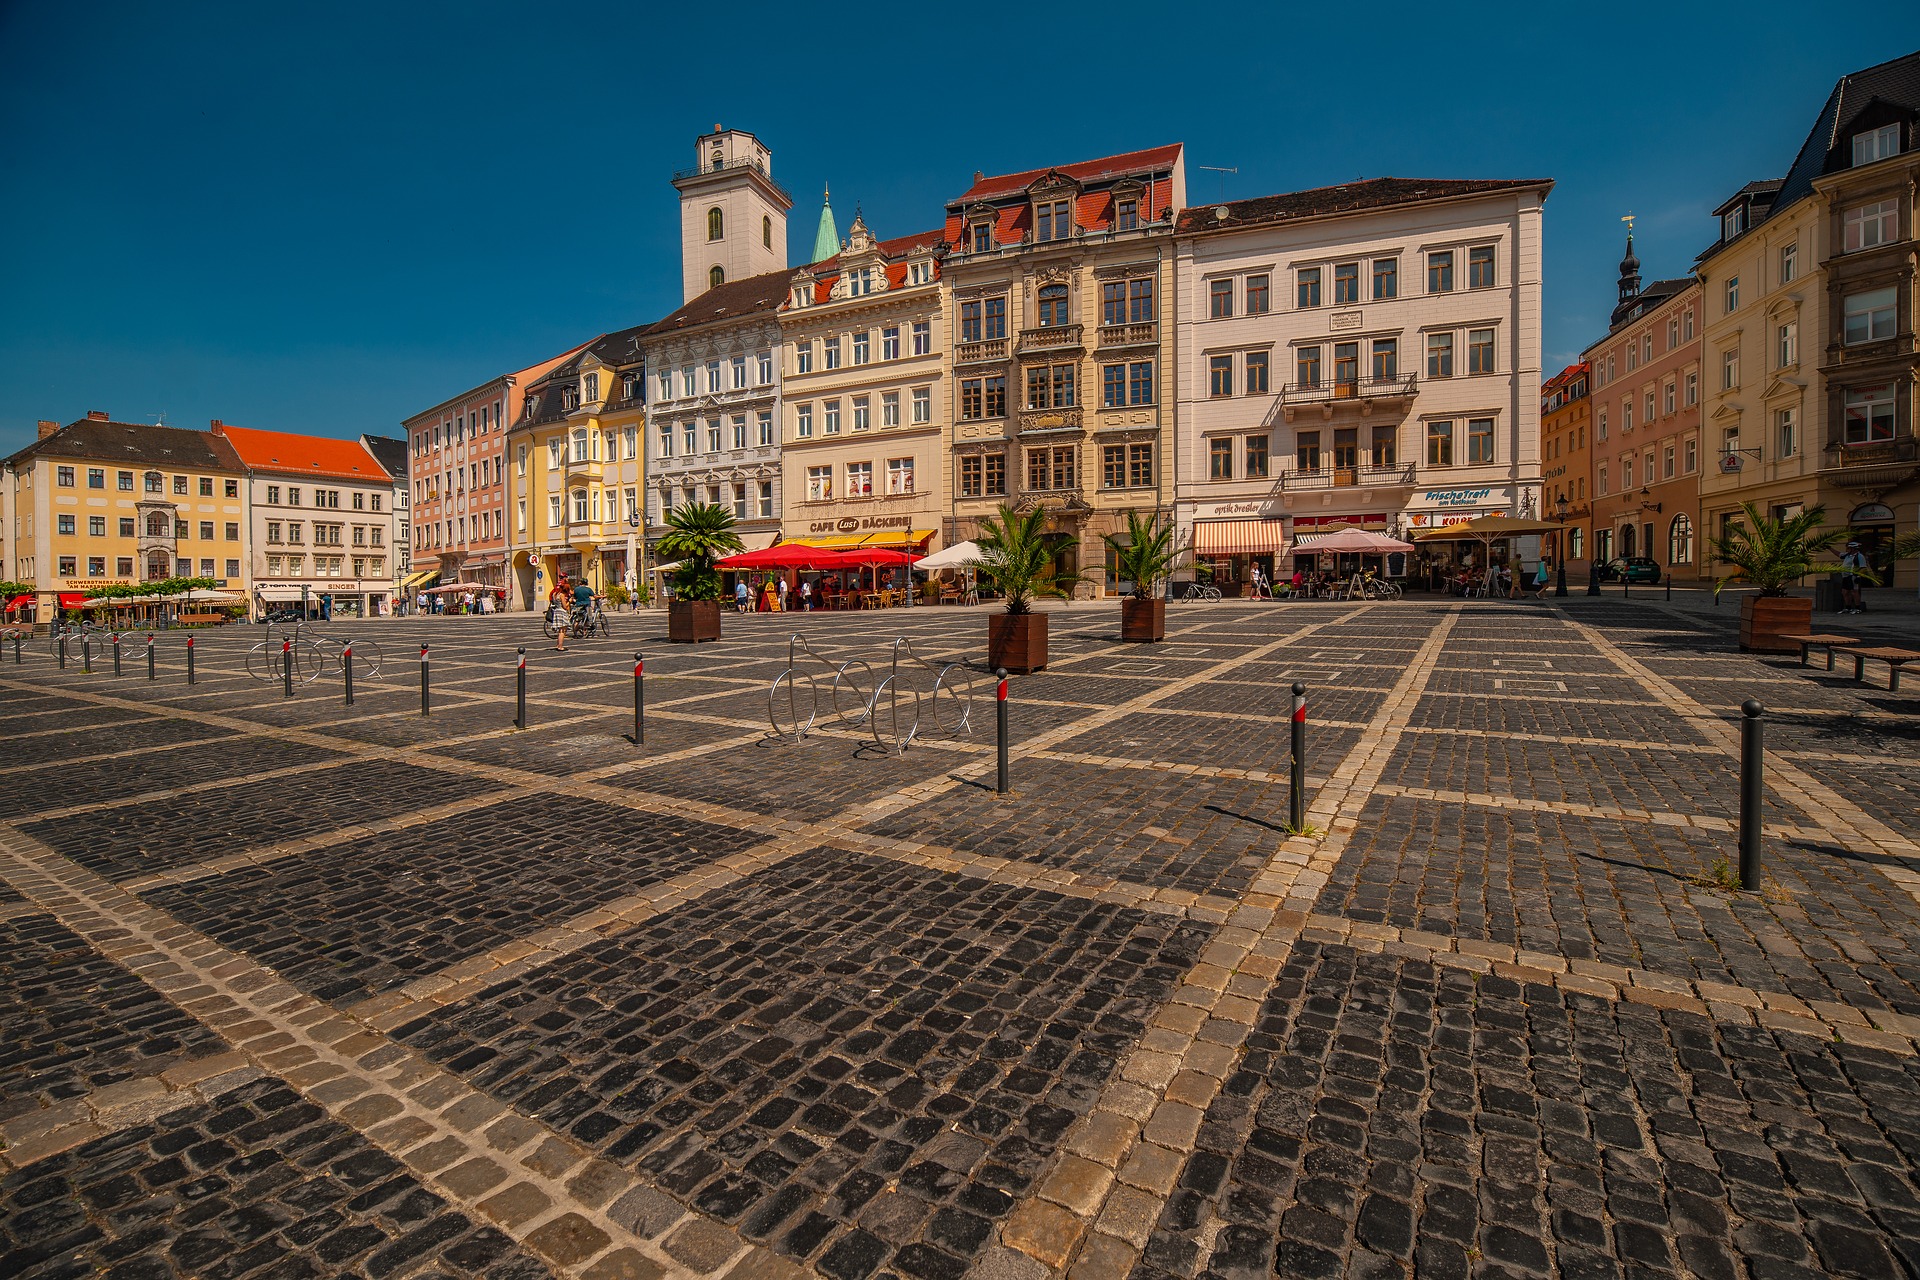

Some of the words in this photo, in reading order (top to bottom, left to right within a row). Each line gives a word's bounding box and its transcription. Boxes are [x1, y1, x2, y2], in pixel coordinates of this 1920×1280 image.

[1425, 488, 1491, 501] FrischeTreff
[1215, 503, 1233, 515] optik
[810, 522, 834, 532] CAFE
[839, 520, 857, 529] Lust
[863, 517, 912, 529] BÄCKEREI
